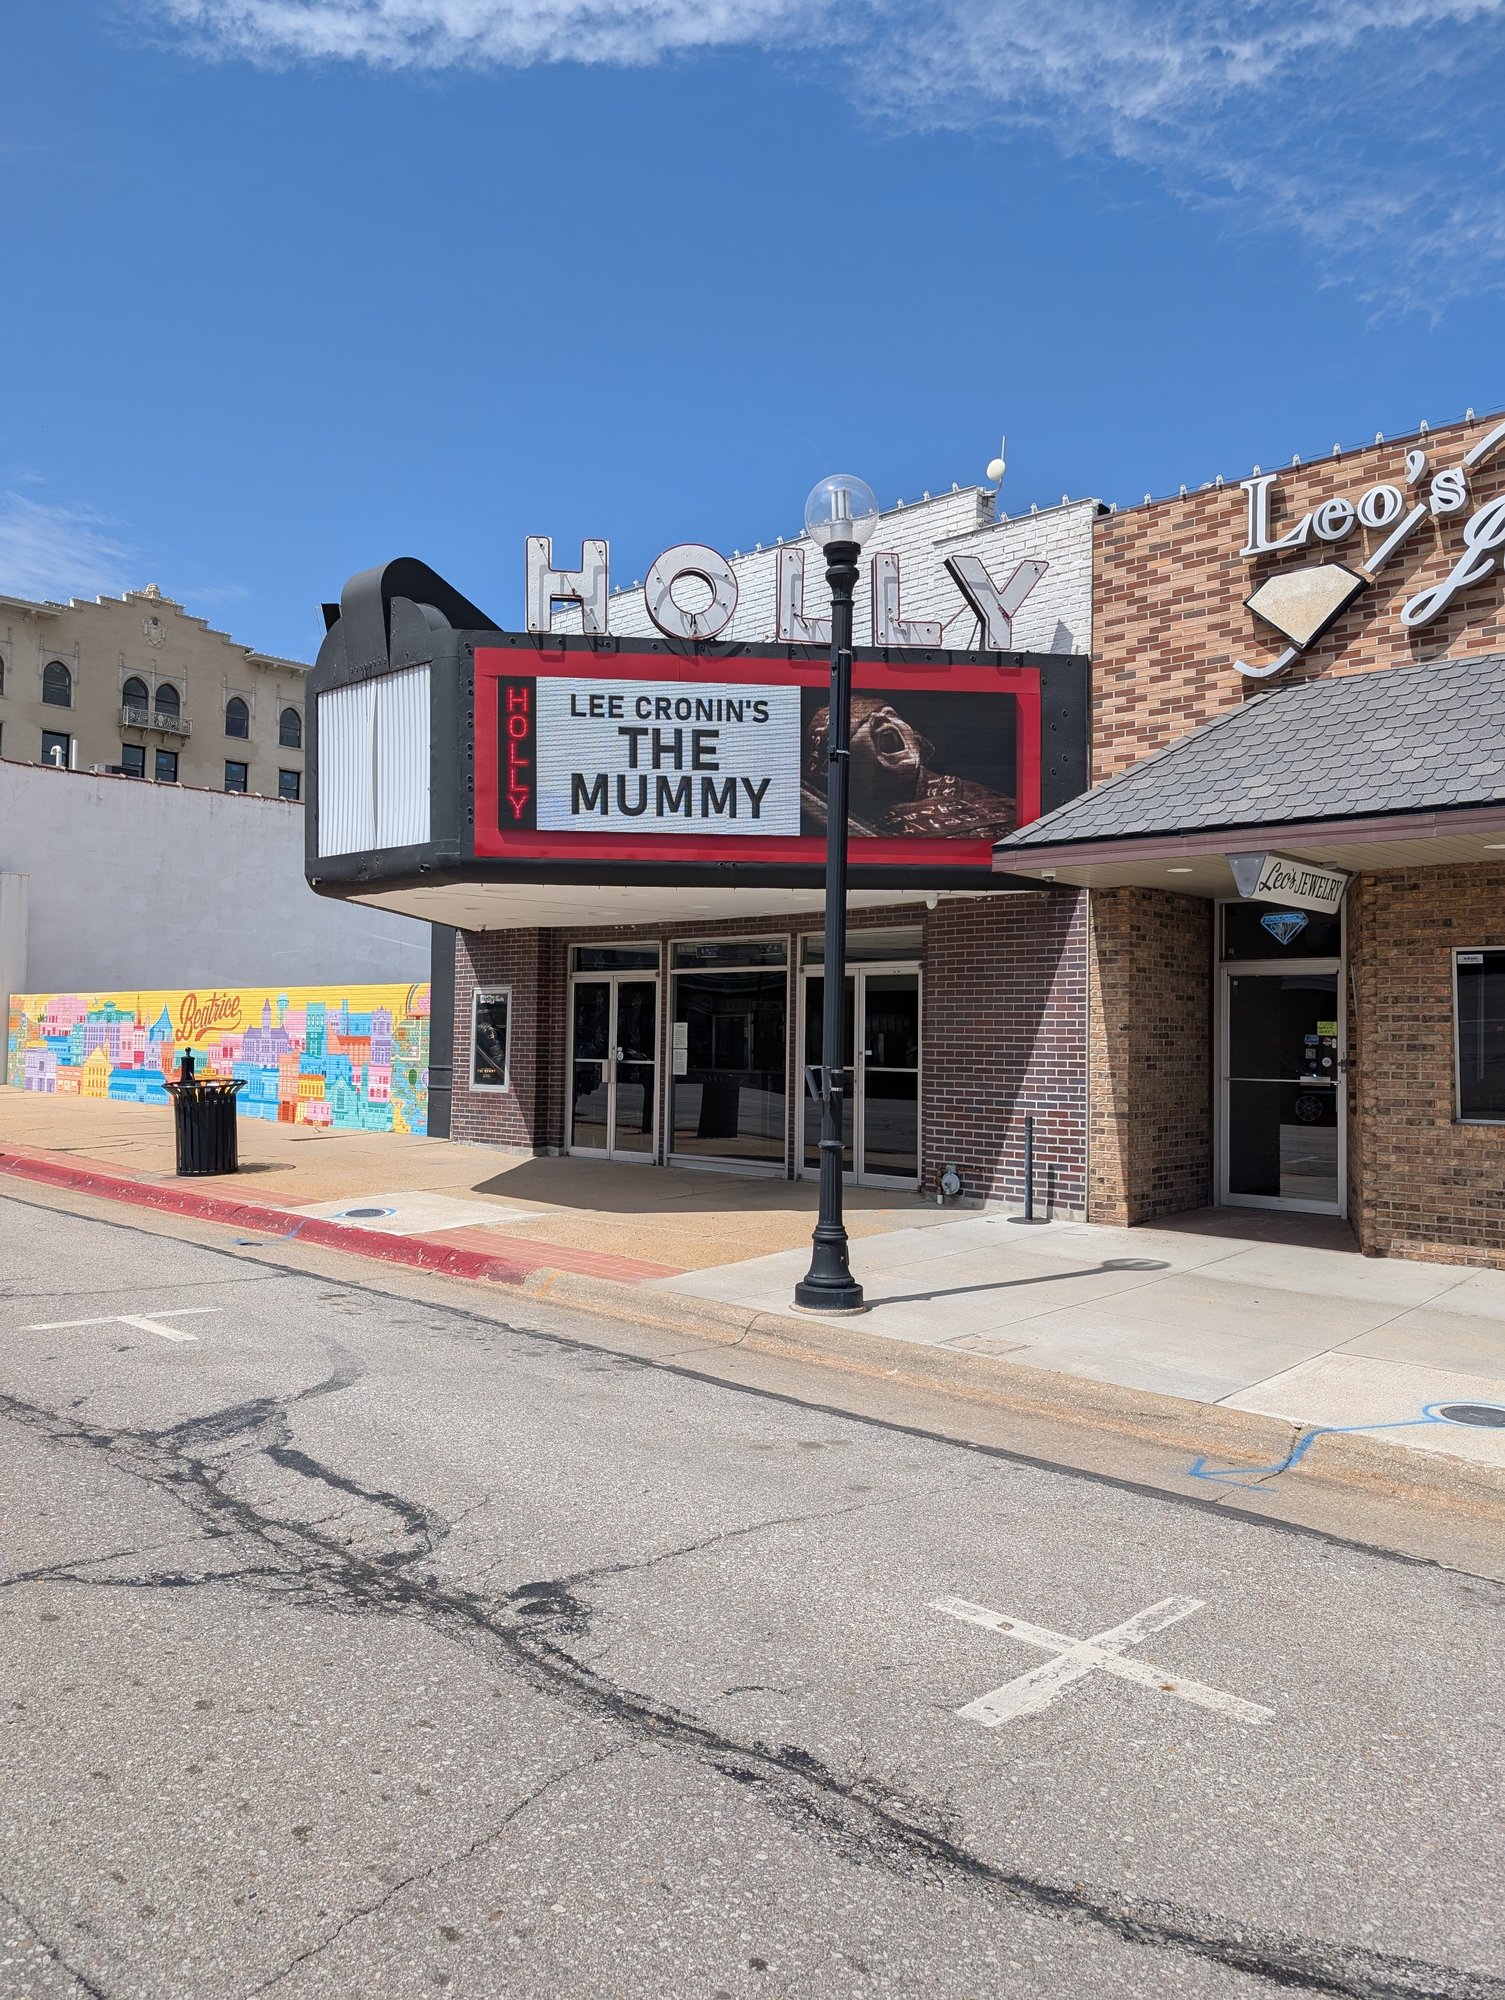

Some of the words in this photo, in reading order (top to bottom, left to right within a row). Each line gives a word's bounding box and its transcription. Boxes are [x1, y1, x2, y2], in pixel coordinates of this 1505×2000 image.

[1239, 450, 1468, 557] Leo's
[525, 535, 1050, 651] HOLLY
[570, 693, 625, 719] LEE
[635, 695, 770, 723] CRONIN'S
[506, 685, 529, 820] HOLLY
[618, 726, 720, 771] THE
[571, 772, 772, 819] MUMMY
[1258, 861, 1297, 892] Leo's
[1293, 871, 1343, 902] JEWELRY
[175, 991, 242, 1042] Beatrice
